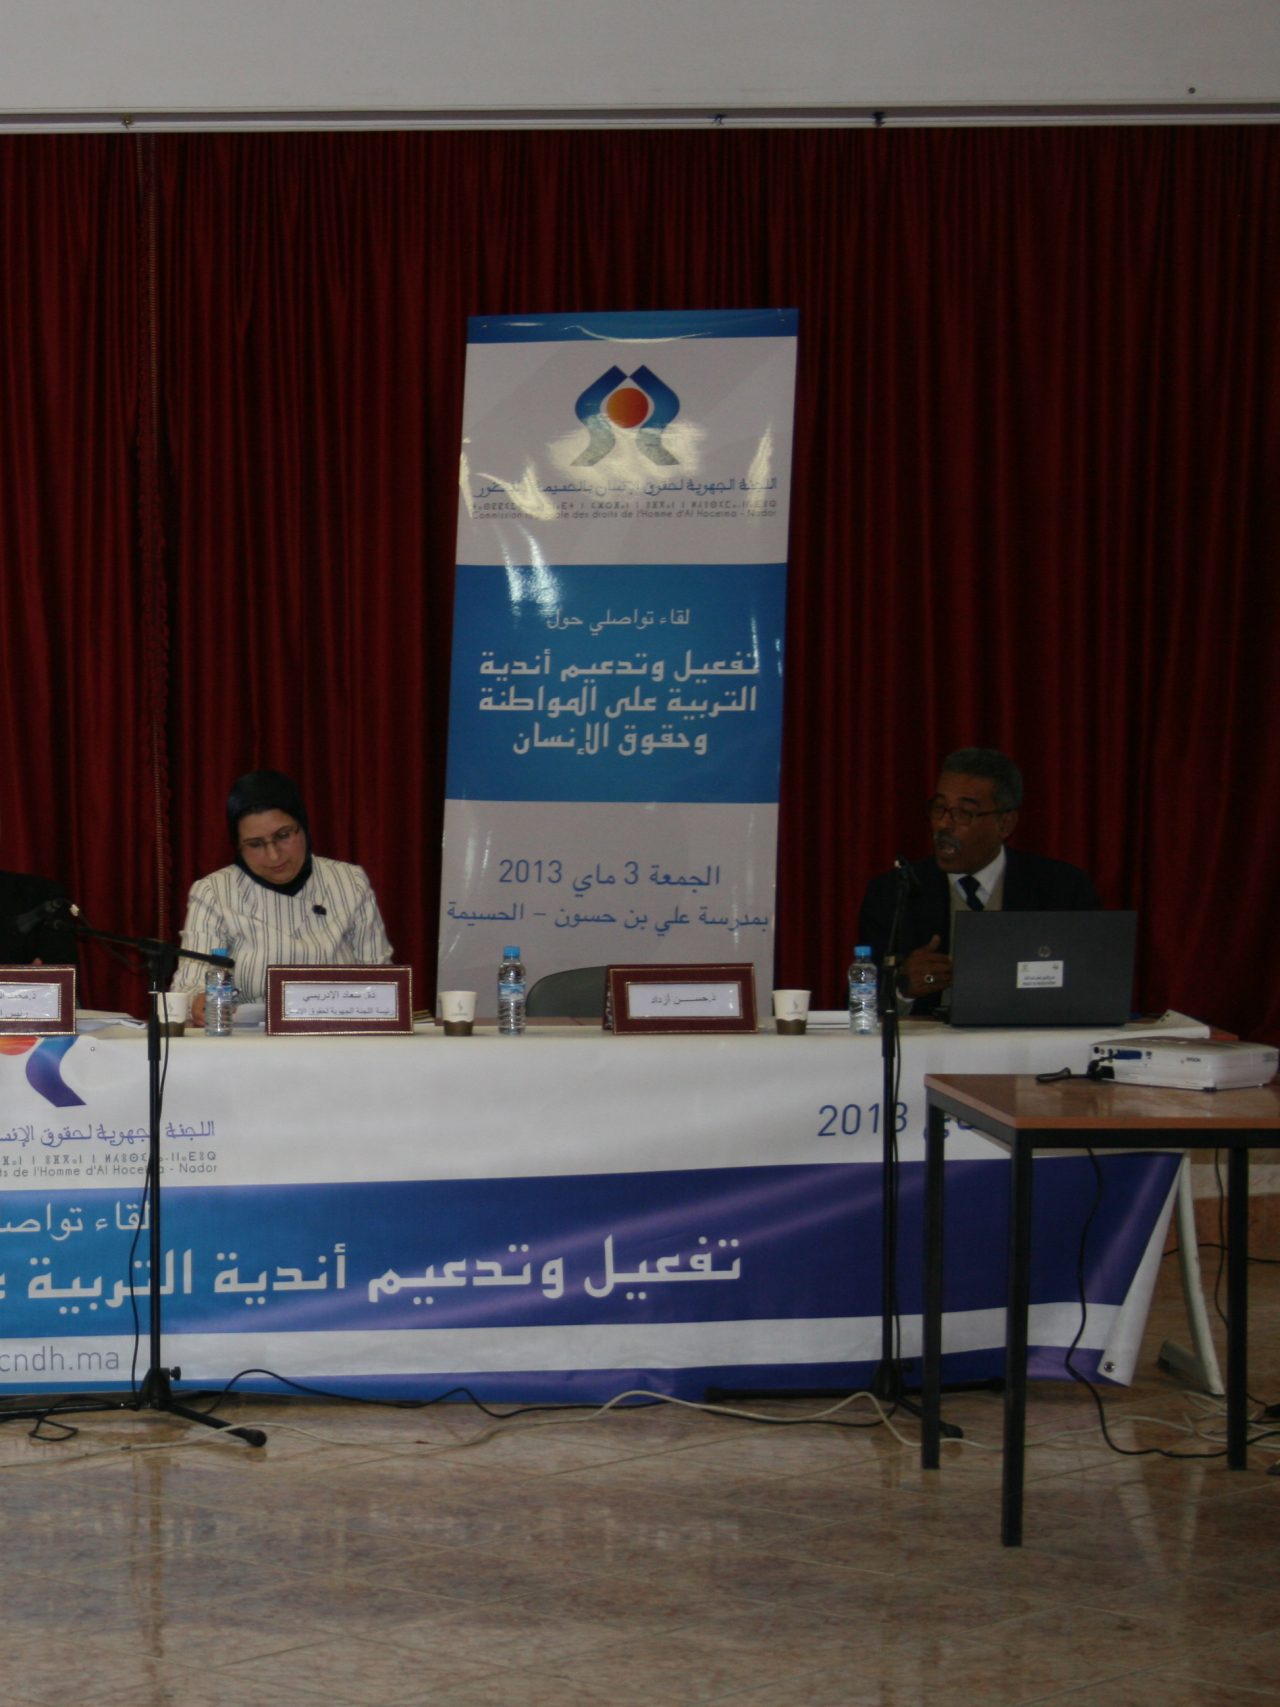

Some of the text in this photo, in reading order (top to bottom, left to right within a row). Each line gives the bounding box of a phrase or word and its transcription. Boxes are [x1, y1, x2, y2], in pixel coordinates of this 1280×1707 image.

[546, 608, 690, 636] لقاء تواصلي حول
[480, 648, 760, 684] تفعيل وتدعيم أندية
[479, 685, 757, 720] التربية على المواطنة
[513, 721, 708, 756] وحقوق الإنسان
[498, 859, 721, 898] الجمعة 3 ماي 2013
[447, 900, 524, 927] الحسيمة
[554, 906, 617, 928] حسون
[623, 911, 648, 930] بن
[654, 904, 690, 937] علي
[698, 904, 769, 934] بمدرسة
[39, 1123, 92, 1148] لحقوق
[165, 1120, 216, 1141] اللجنة
[817, 1102, 907, 1137] 2013
[13, 1166, 29, 1177] de
[33, 1164, 84, 1177] l'Homme
[86, 1164, 109, 1176] d'Al
[179, 1162, 218, 1174] Nador
[213, 1243, 347, 1305] أندية
[368, 1243, 566, 1305] وتدعيم
[583, 1235, 742, 1301] تفعيل
